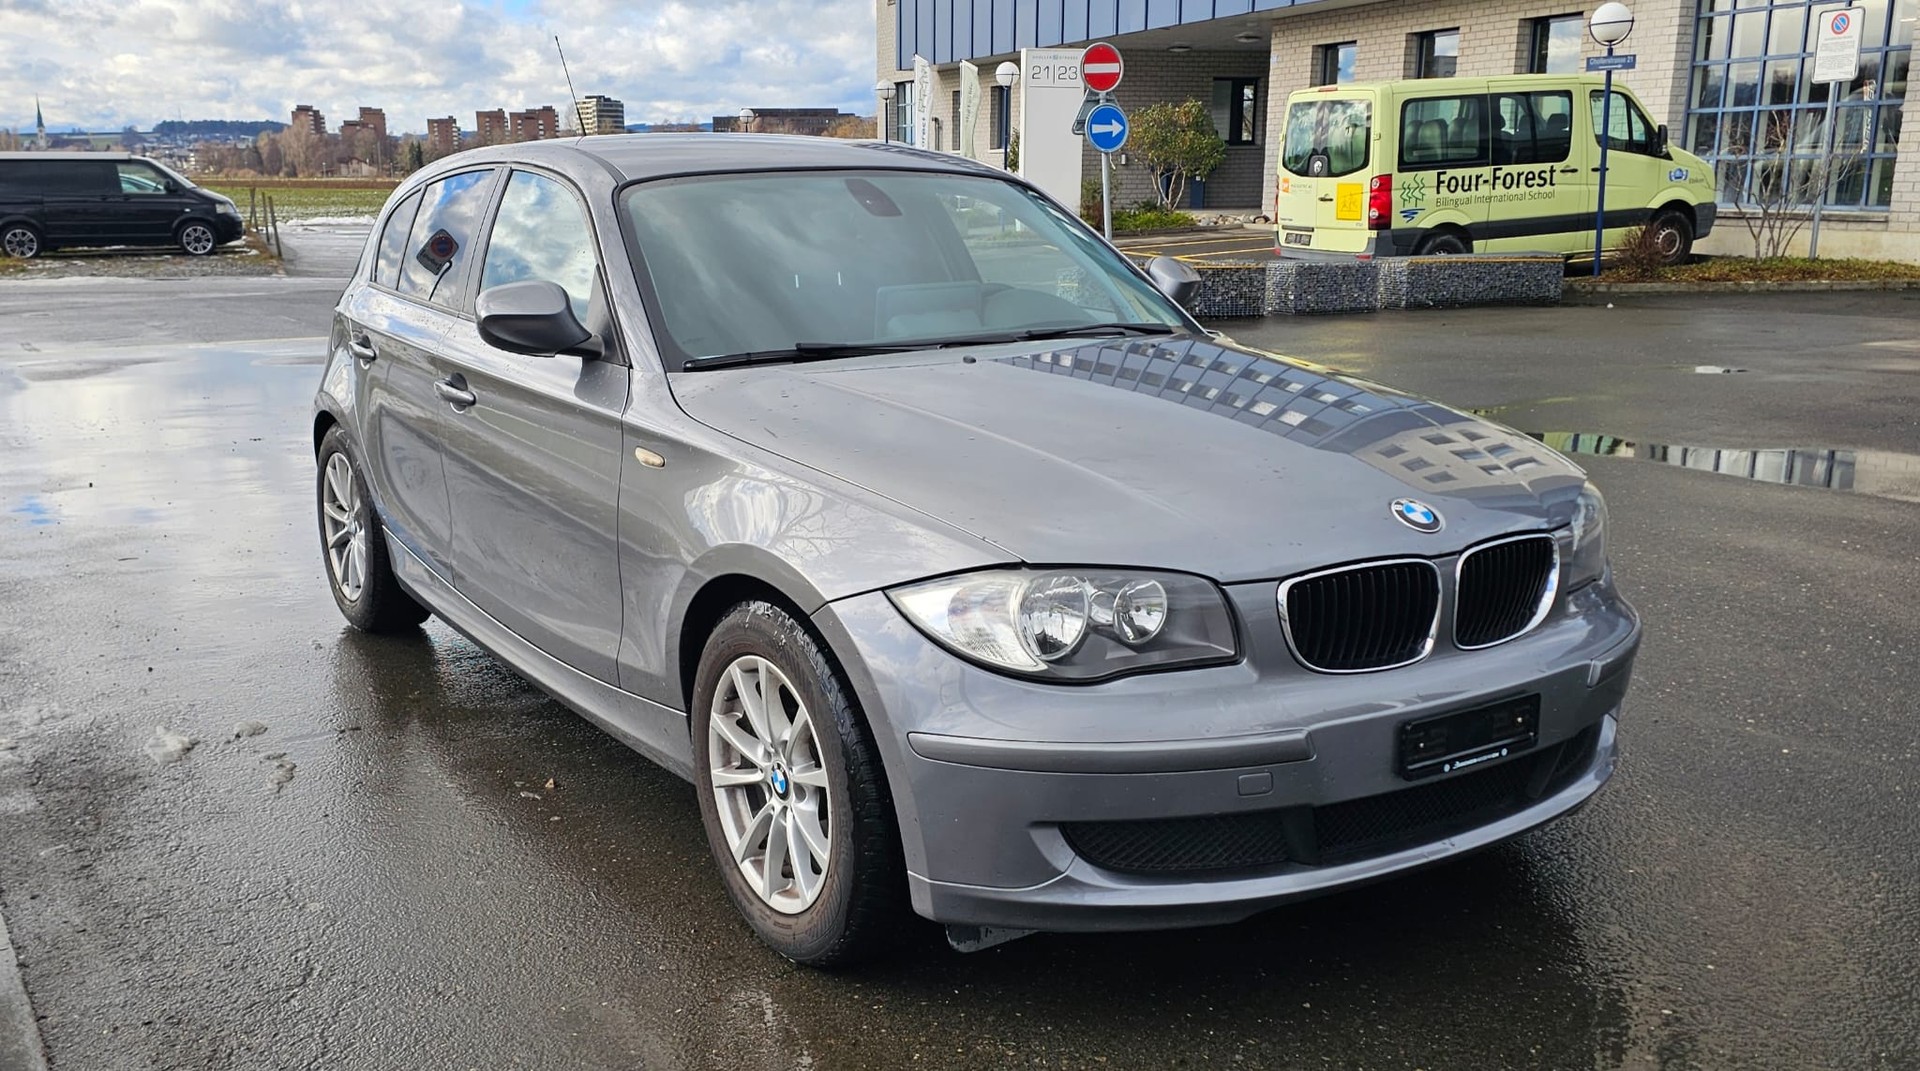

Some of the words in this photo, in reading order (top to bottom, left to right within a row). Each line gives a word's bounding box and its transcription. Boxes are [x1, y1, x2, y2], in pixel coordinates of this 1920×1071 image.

[1436, 165, 1556, 194] Four-Forest
[1436, 195, 1473, 207] Bilingual
[1474, 192, 1526, 204] International
[1528, 189, 1556, 200] School
